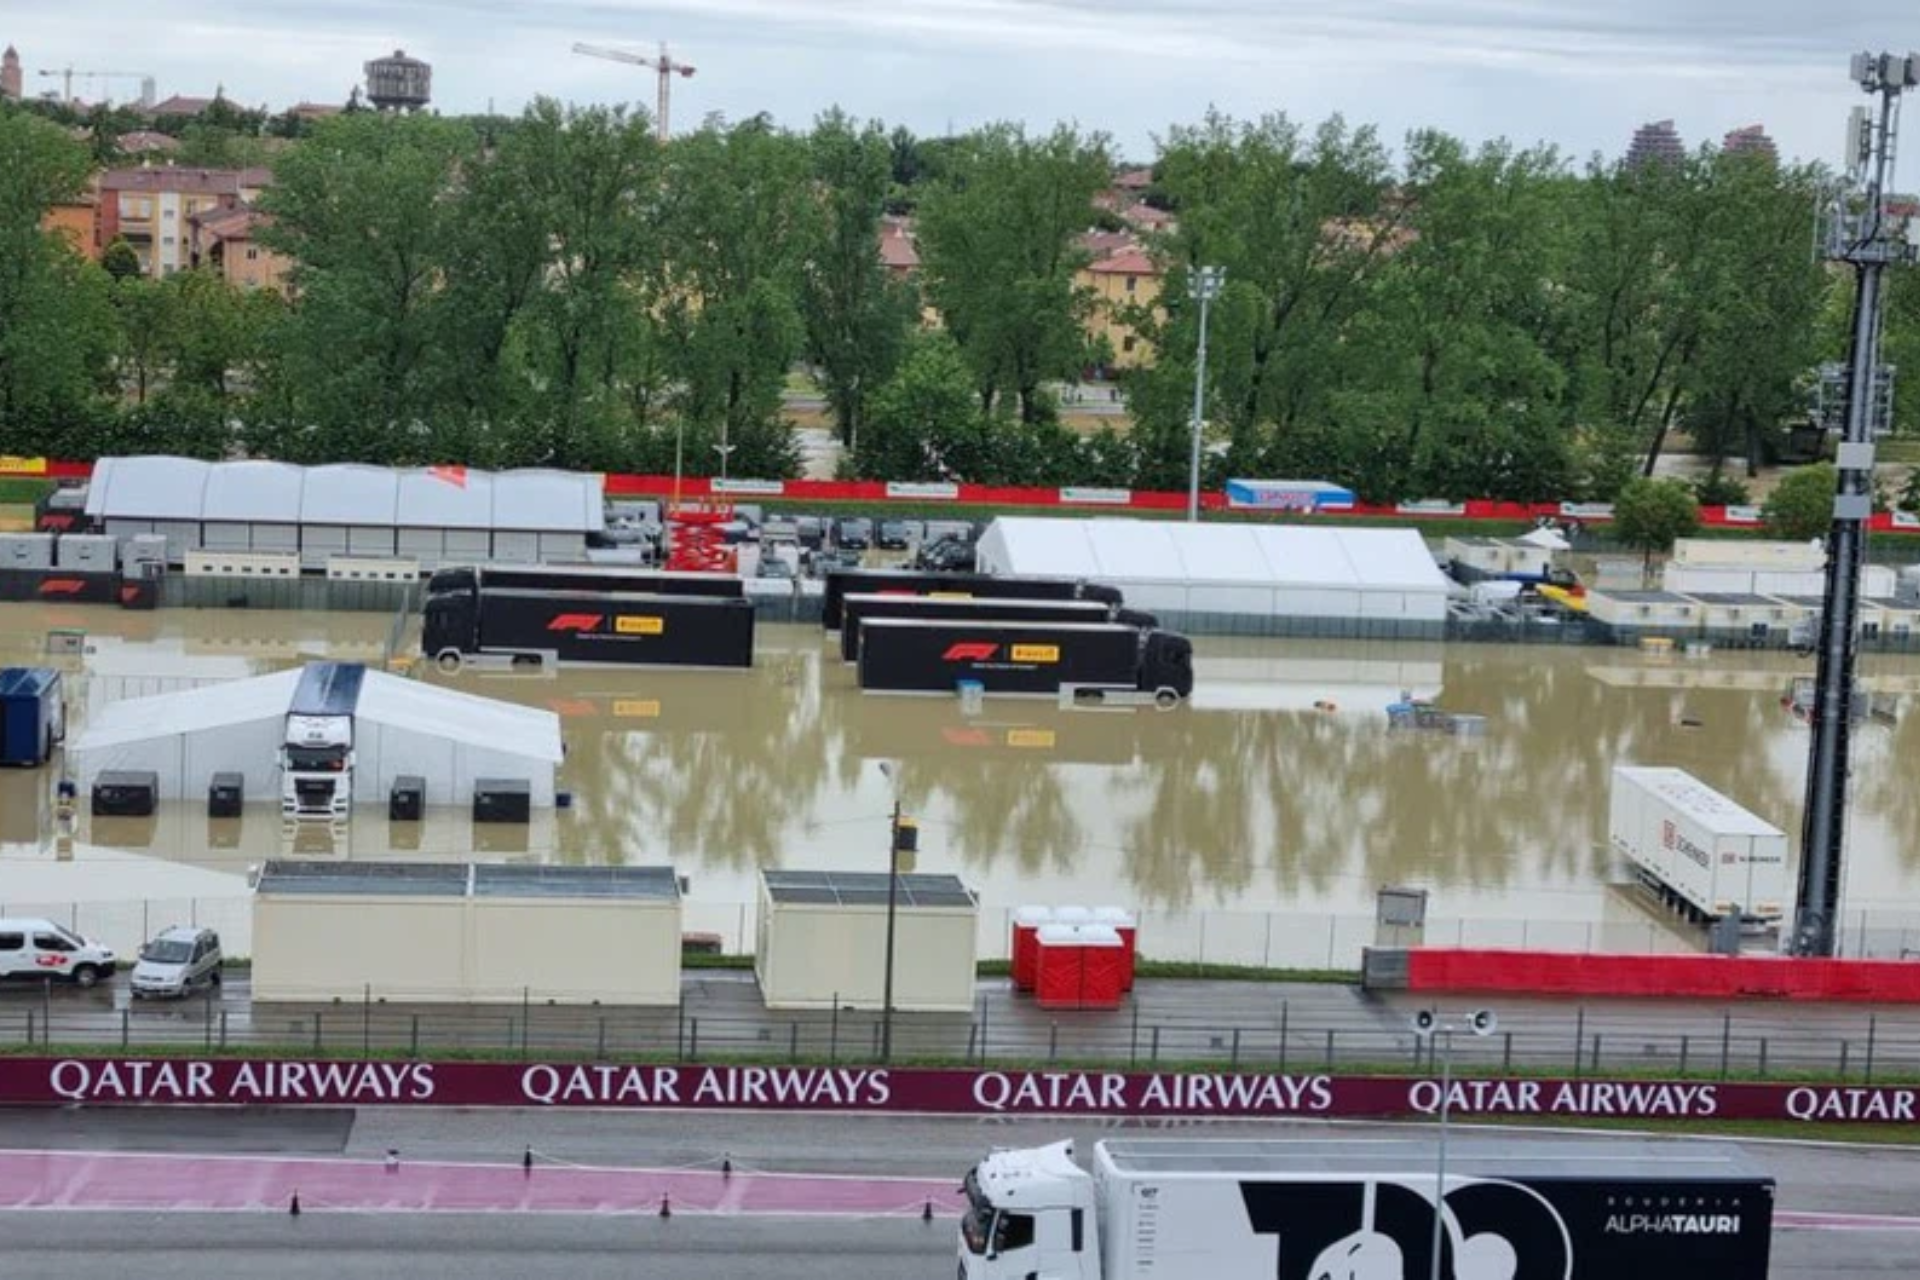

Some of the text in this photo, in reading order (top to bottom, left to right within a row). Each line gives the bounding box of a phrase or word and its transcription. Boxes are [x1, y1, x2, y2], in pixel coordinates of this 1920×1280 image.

[50, 1061, 435, 1099] QATAR AIRWAYS
[521, 1065, 890, 1103] QATAR AIRWAYS
[973, 1072, 1332, 1110] QATAR AIRWAYS
[1408, 1081, 1717, 1116] QATAR AIRWAYS
[1786, 1087, 1916, 1121] QATAR
[1605, 1214, 1741, 1233] ALPHATAURI
